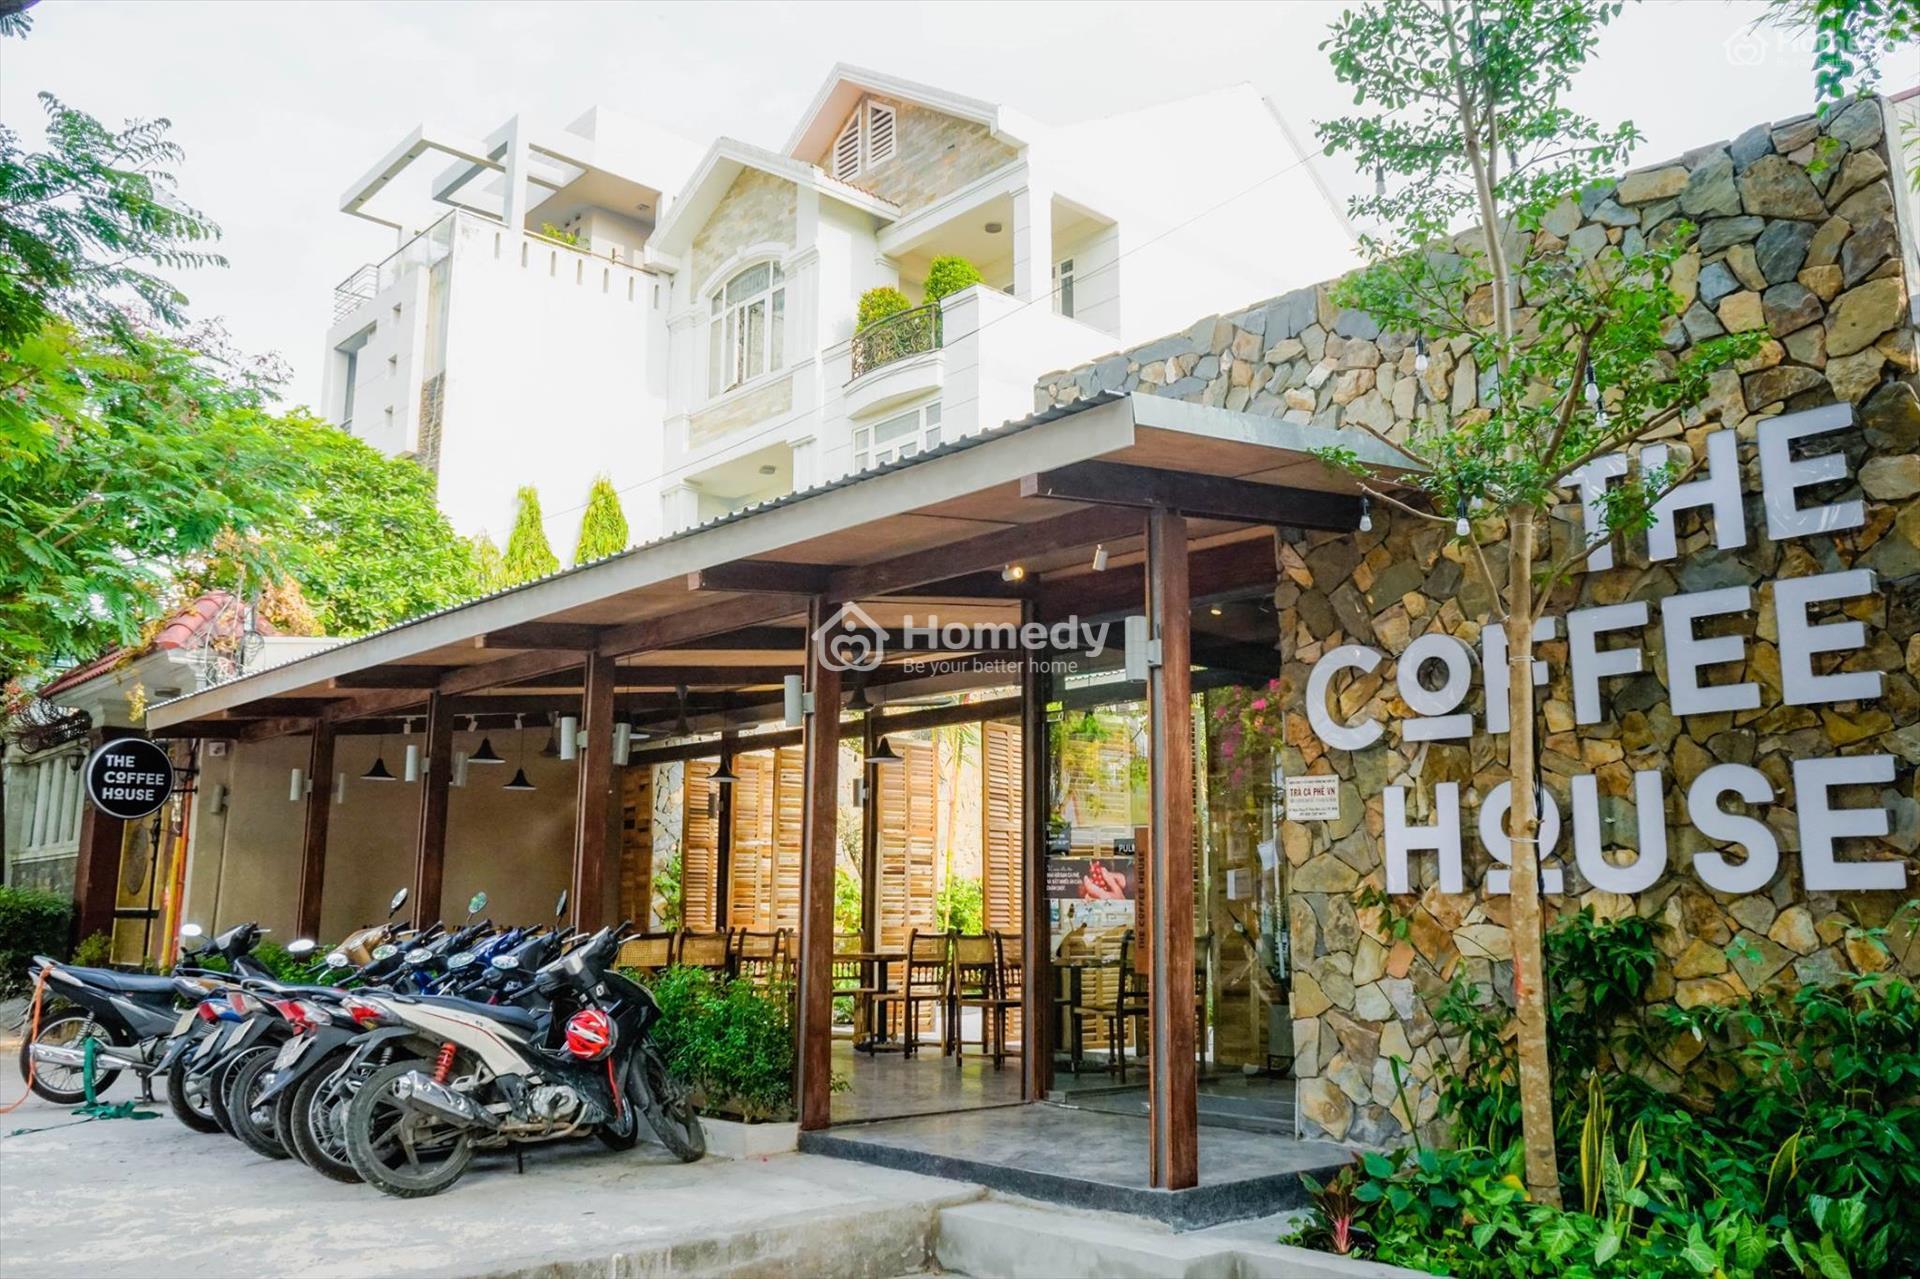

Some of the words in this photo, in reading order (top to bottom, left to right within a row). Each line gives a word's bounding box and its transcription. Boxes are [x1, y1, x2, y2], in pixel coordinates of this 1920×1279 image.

[1559, 401, 1866, 572] THE
[1306, 569, 1884, 751] COFFEE
[101, 787, 155, 801] HOUSE
[104, 771, 165, 785] COFFEE
[105, 755, 136, 768] THE
[1384, 755, 1907, 895] HOUSE
